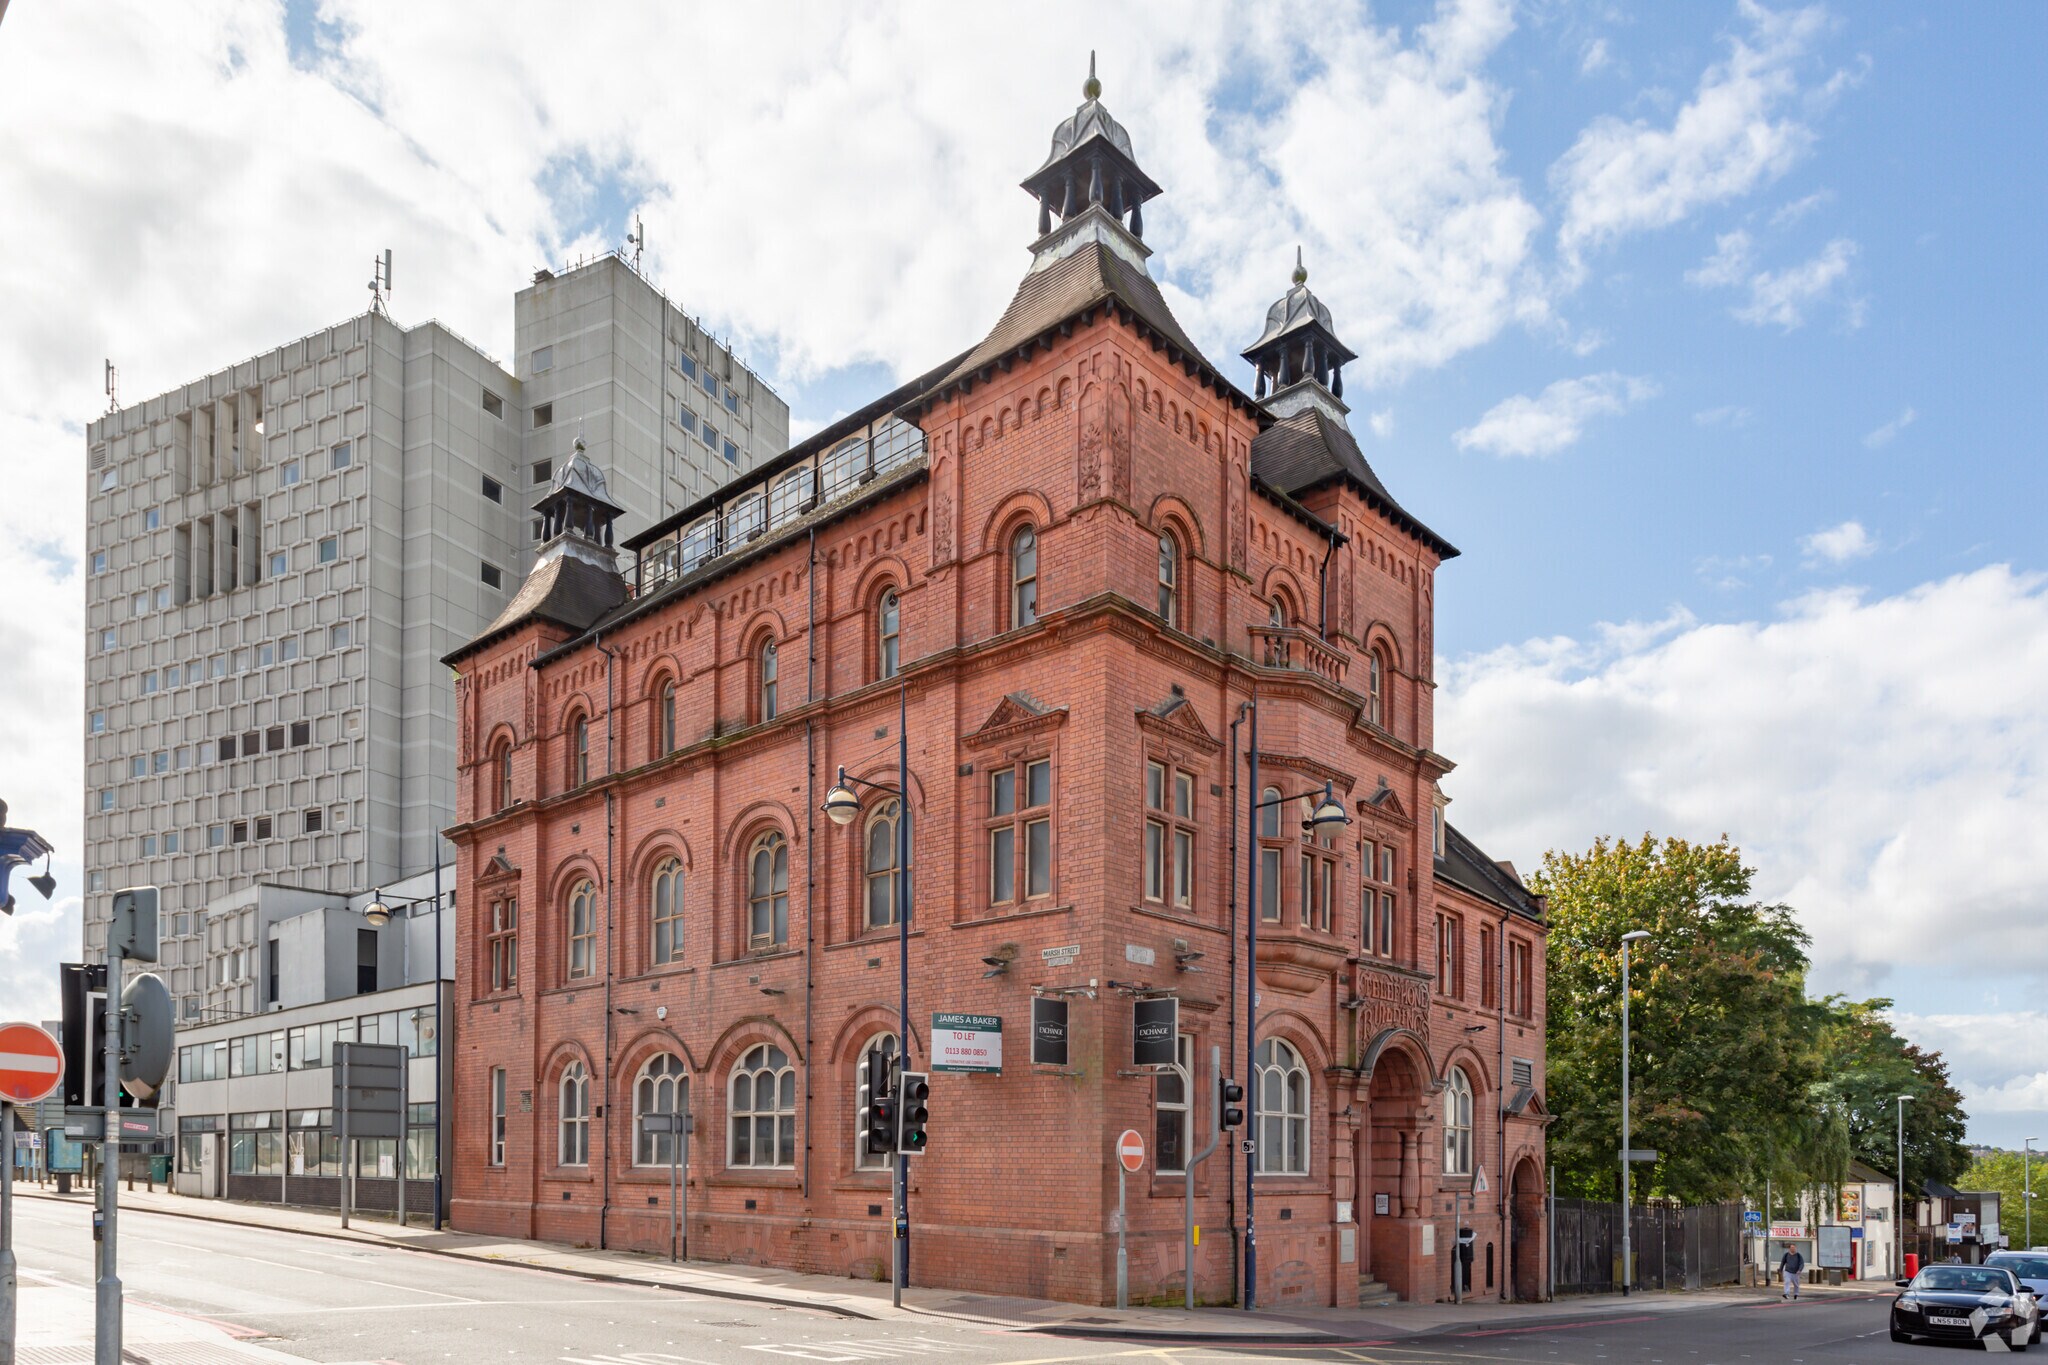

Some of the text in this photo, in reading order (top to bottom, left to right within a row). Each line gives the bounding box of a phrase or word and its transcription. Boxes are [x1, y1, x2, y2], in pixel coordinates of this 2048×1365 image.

[1043, 946, 1079, 958] MARSH STREET
[1361, 977, 1430, 1009] TELEPHONE
[938, 1014, 998, 1026] JAMES A BAKER
[1363, 1002, 1430, 1042] BUILDINGS
[953, 1031, 976, 1041] TO LET
[1039, 1026, 1064, 1036] EXCHANGE
[1139, 1027, 1169, 1036] EXCHANGE
[945, 1046, 960, 1055] 0113
[741, 1336, 998, 1362] ENTRY
